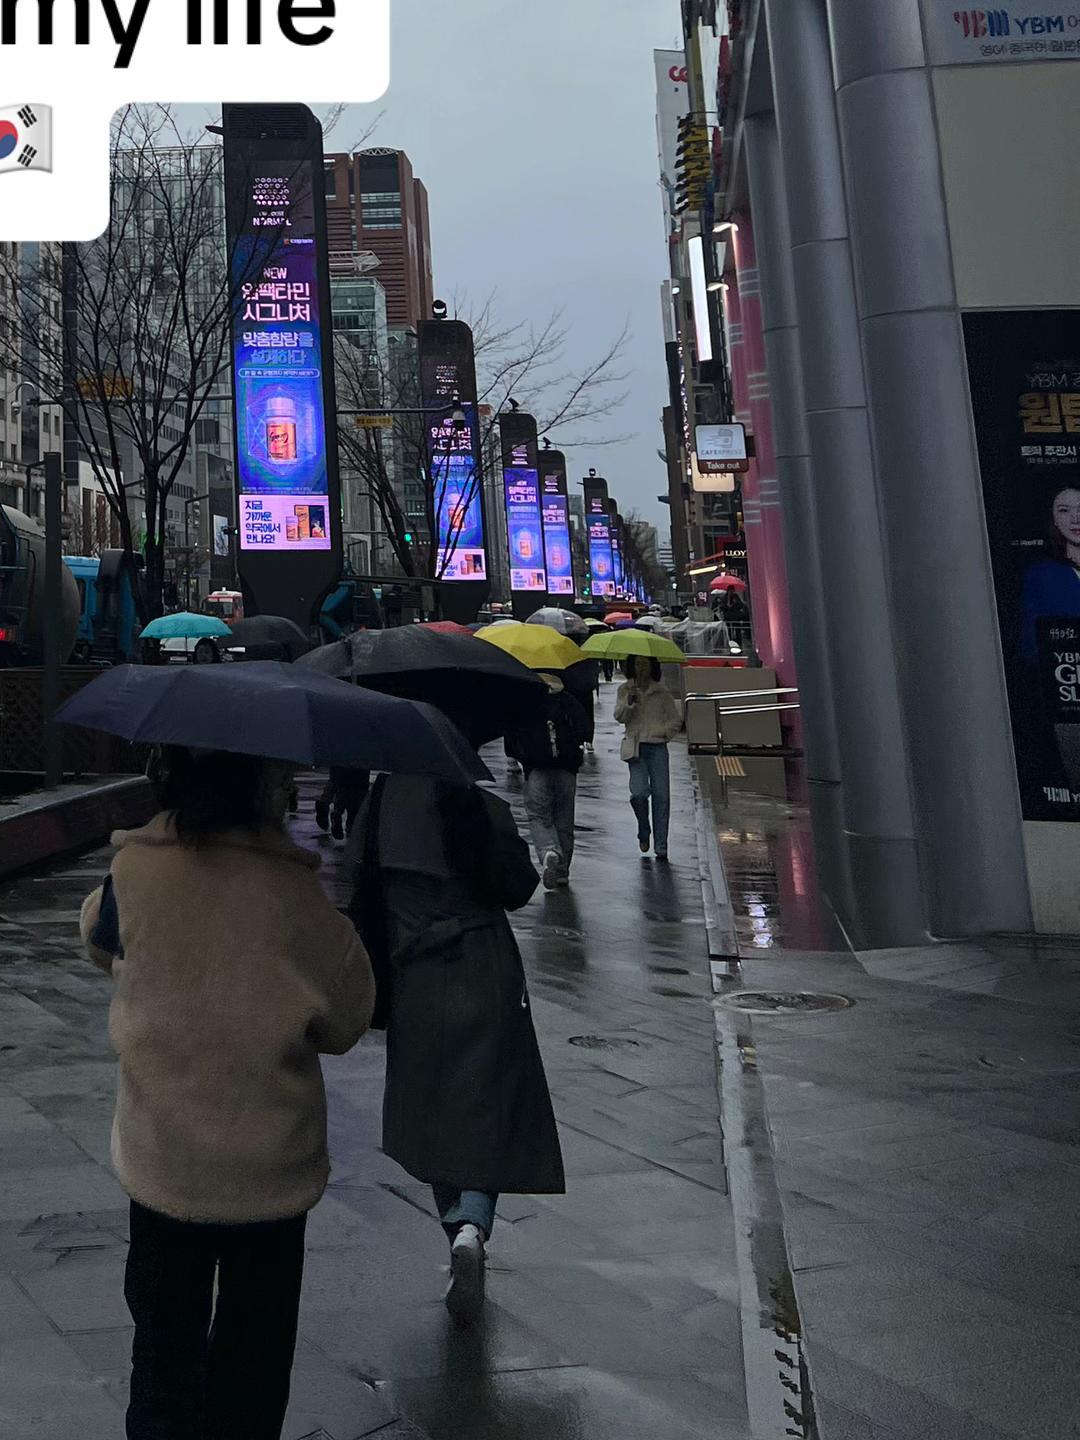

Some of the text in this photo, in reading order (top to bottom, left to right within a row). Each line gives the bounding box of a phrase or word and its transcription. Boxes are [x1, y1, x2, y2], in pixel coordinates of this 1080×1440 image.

[1014, 15, 1065, 35] YBM
[264, 267, 287, 279] NEW
[242, 303, 311, 322] 시그니처
[706, 461, 725, 469] Take
[245, 500, 263, 510] 지금
[245, 512, 272, 521] 가까운
[245, 523, 281, 533] 약국에서
[246, 534, 275, 544] 만나요!
